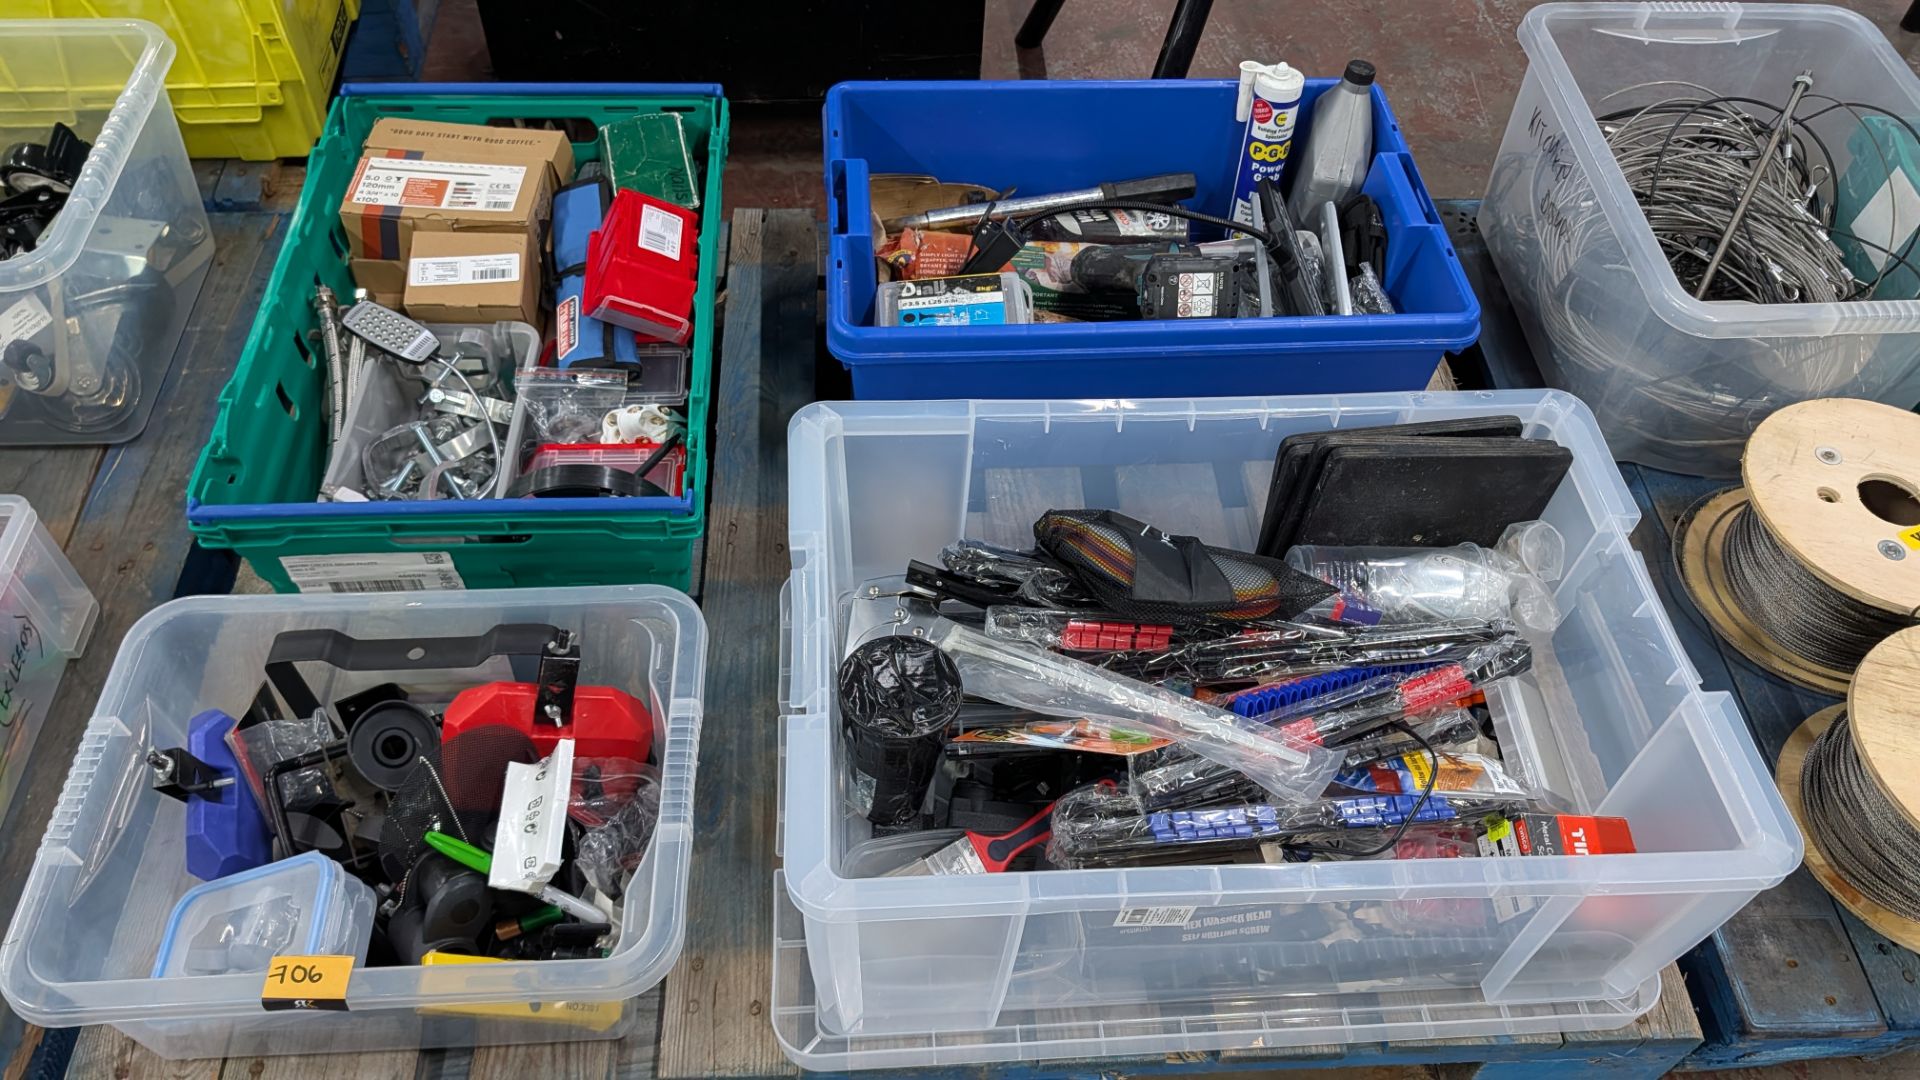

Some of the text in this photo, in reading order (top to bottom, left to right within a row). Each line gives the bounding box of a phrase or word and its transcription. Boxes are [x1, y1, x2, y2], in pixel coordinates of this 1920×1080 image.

[437, 132, 460, 140] START
[463, 134, 482, 142] WITH
[1203, 913, 1245, 926] WASHER
[1246, 909, 1272, 921] HEAD
[1182, 932, 1200, 942] SELF
[268, 964, 323, 984] 706
